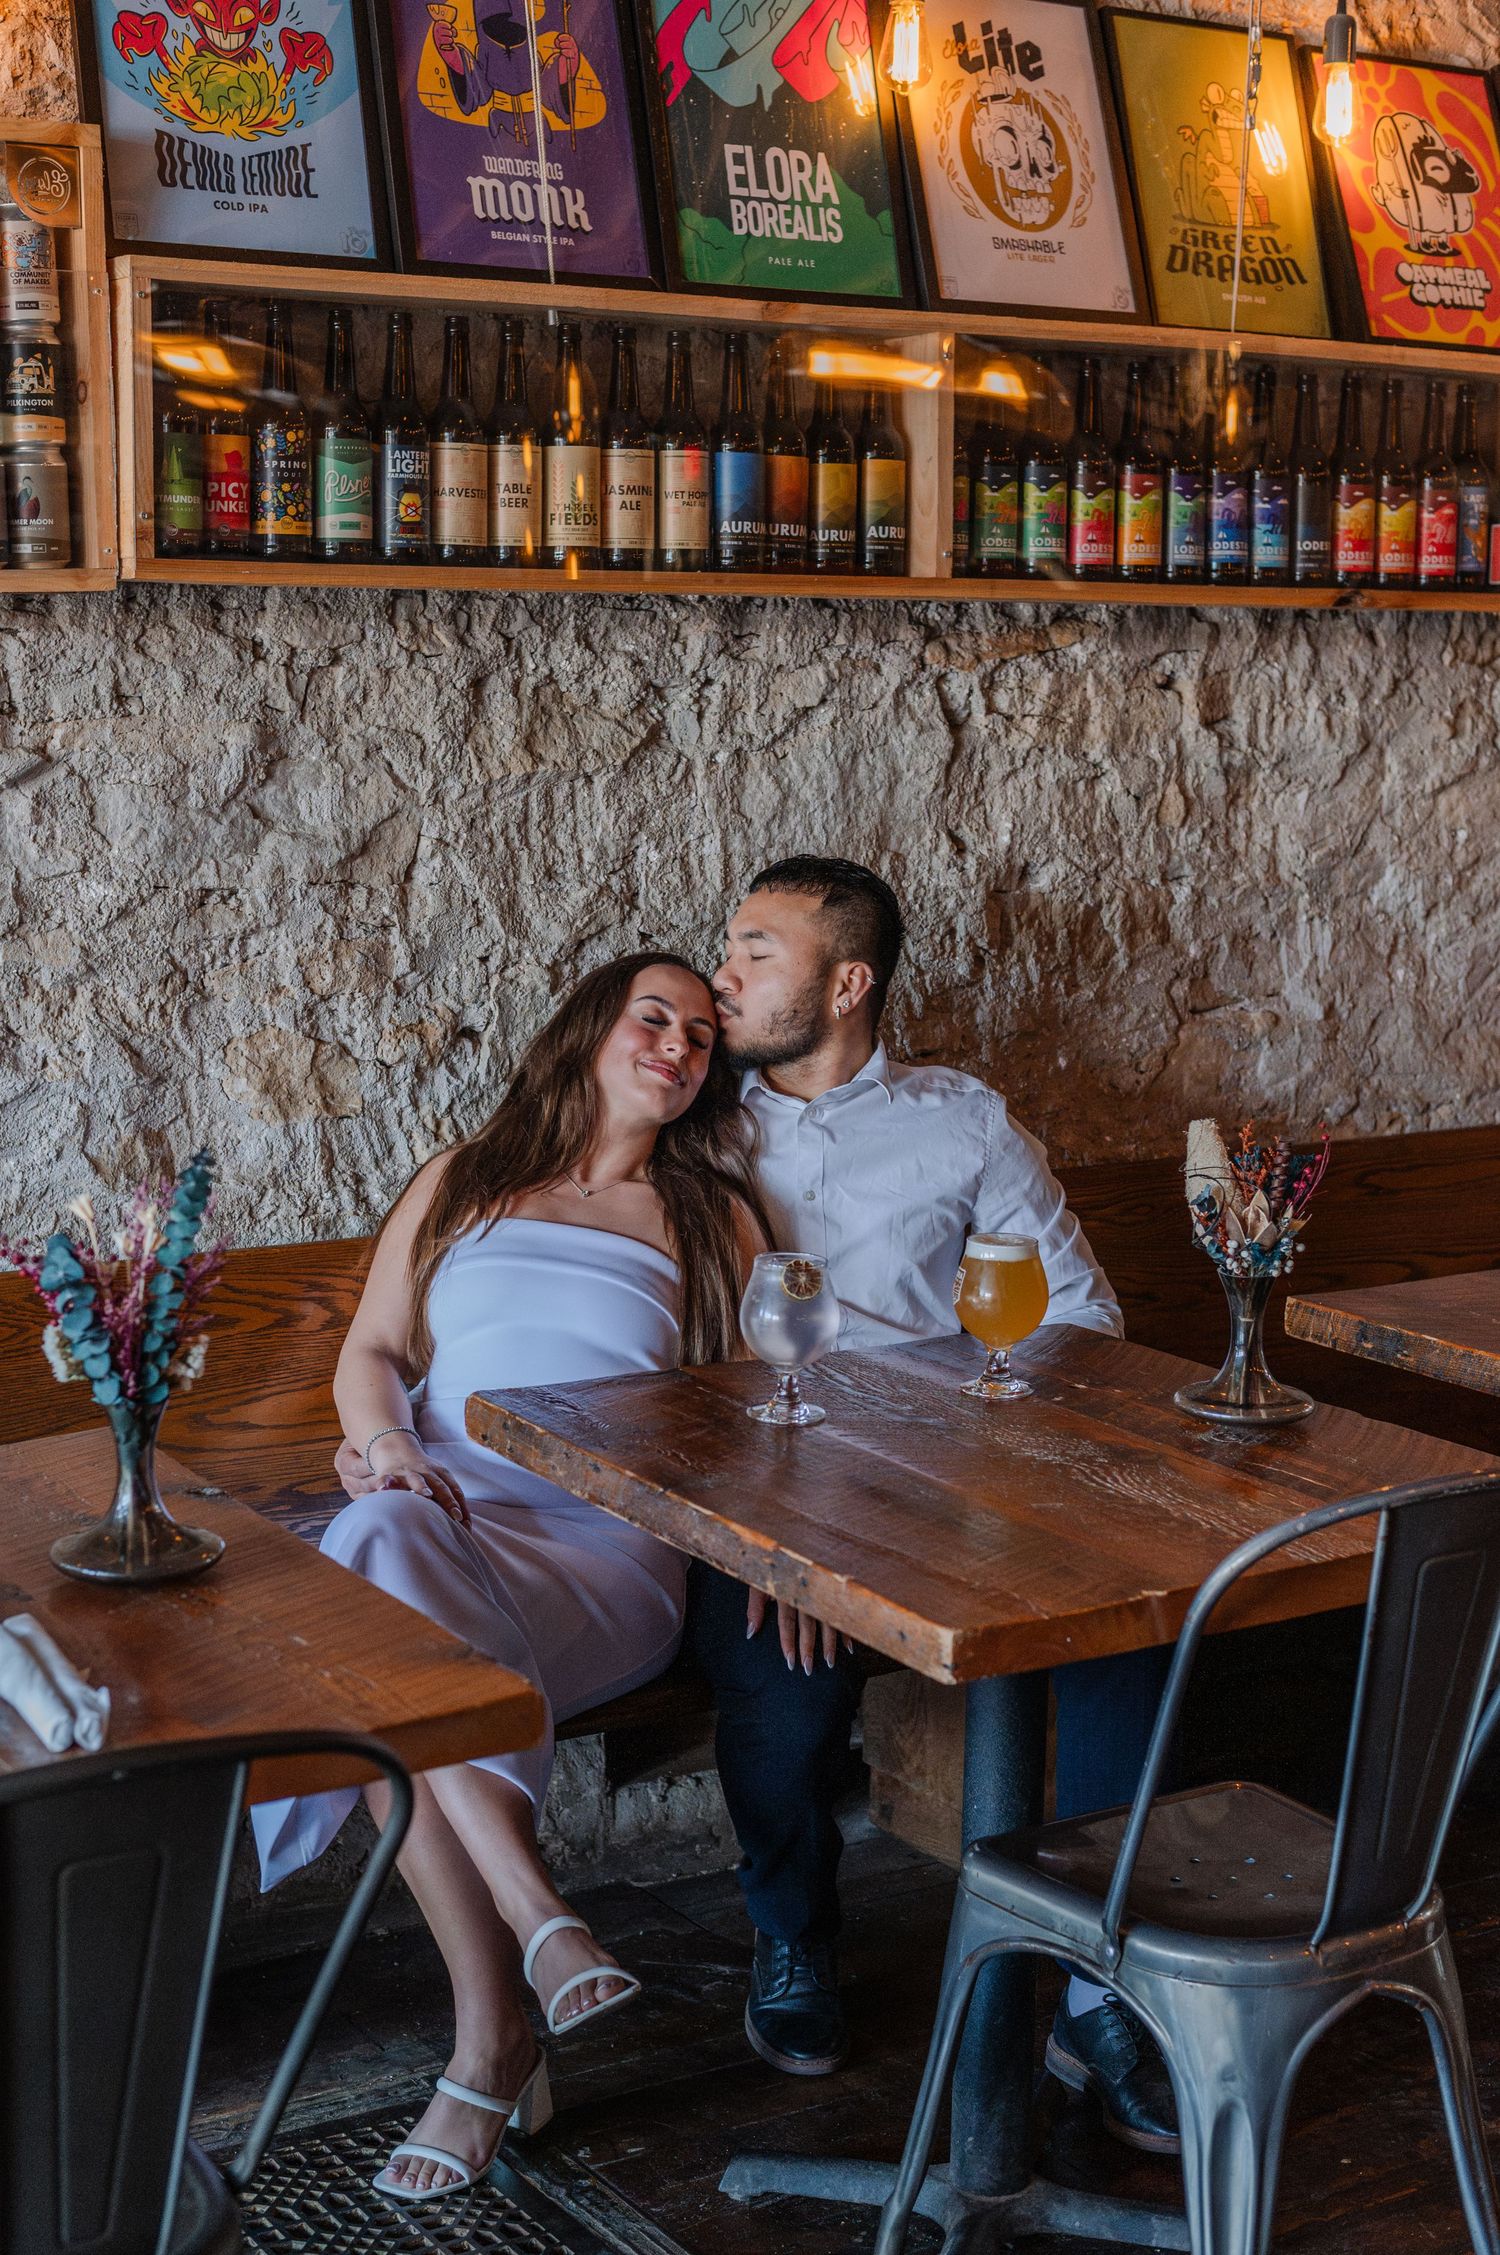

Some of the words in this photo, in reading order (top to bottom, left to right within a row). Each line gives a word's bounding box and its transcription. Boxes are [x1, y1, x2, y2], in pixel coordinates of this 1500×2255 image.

[154, 128, 236, 194] DEVILS
[241, 142, 319, 198] LETTUCE
[482, 155, 564, 180] WANDERNG
[723, 143, 840, 205] ELORA
[213, 200, 244, 212] COLD
[248, 203, 269, 214] IPA
[466, 175, 594, 235] MONK
[729, 199, 844, 243] BOREALIS
[490, 230, 530, 242] BELGIAN
[532, 234, 558, 245] STYE
[560, 237, 576, 247] IPA
[992, 236, 1067, 256] SMASHABLE
[768, 256, 792, 266] PALE
[797, 258, 816, 268] ALE
[1165, 243, 1308, 286] DRAGON
[1396, 261, 1492, 294] OATMEAL
[1409, 283, 1486, 311] GOTHIC
[387, 450, 430, 459] LANTERN
[264, 460, 307, 469] SPRING
[387, 459, 430, 474] LIGHT
[496, 483, 532, 494] TABLE
[664, 491, 685, 499] WET
[500, 498, 528, 508] BEER
[619, 501, 641, 510] ALE
[550, 513, 598, 526] FIELDS
